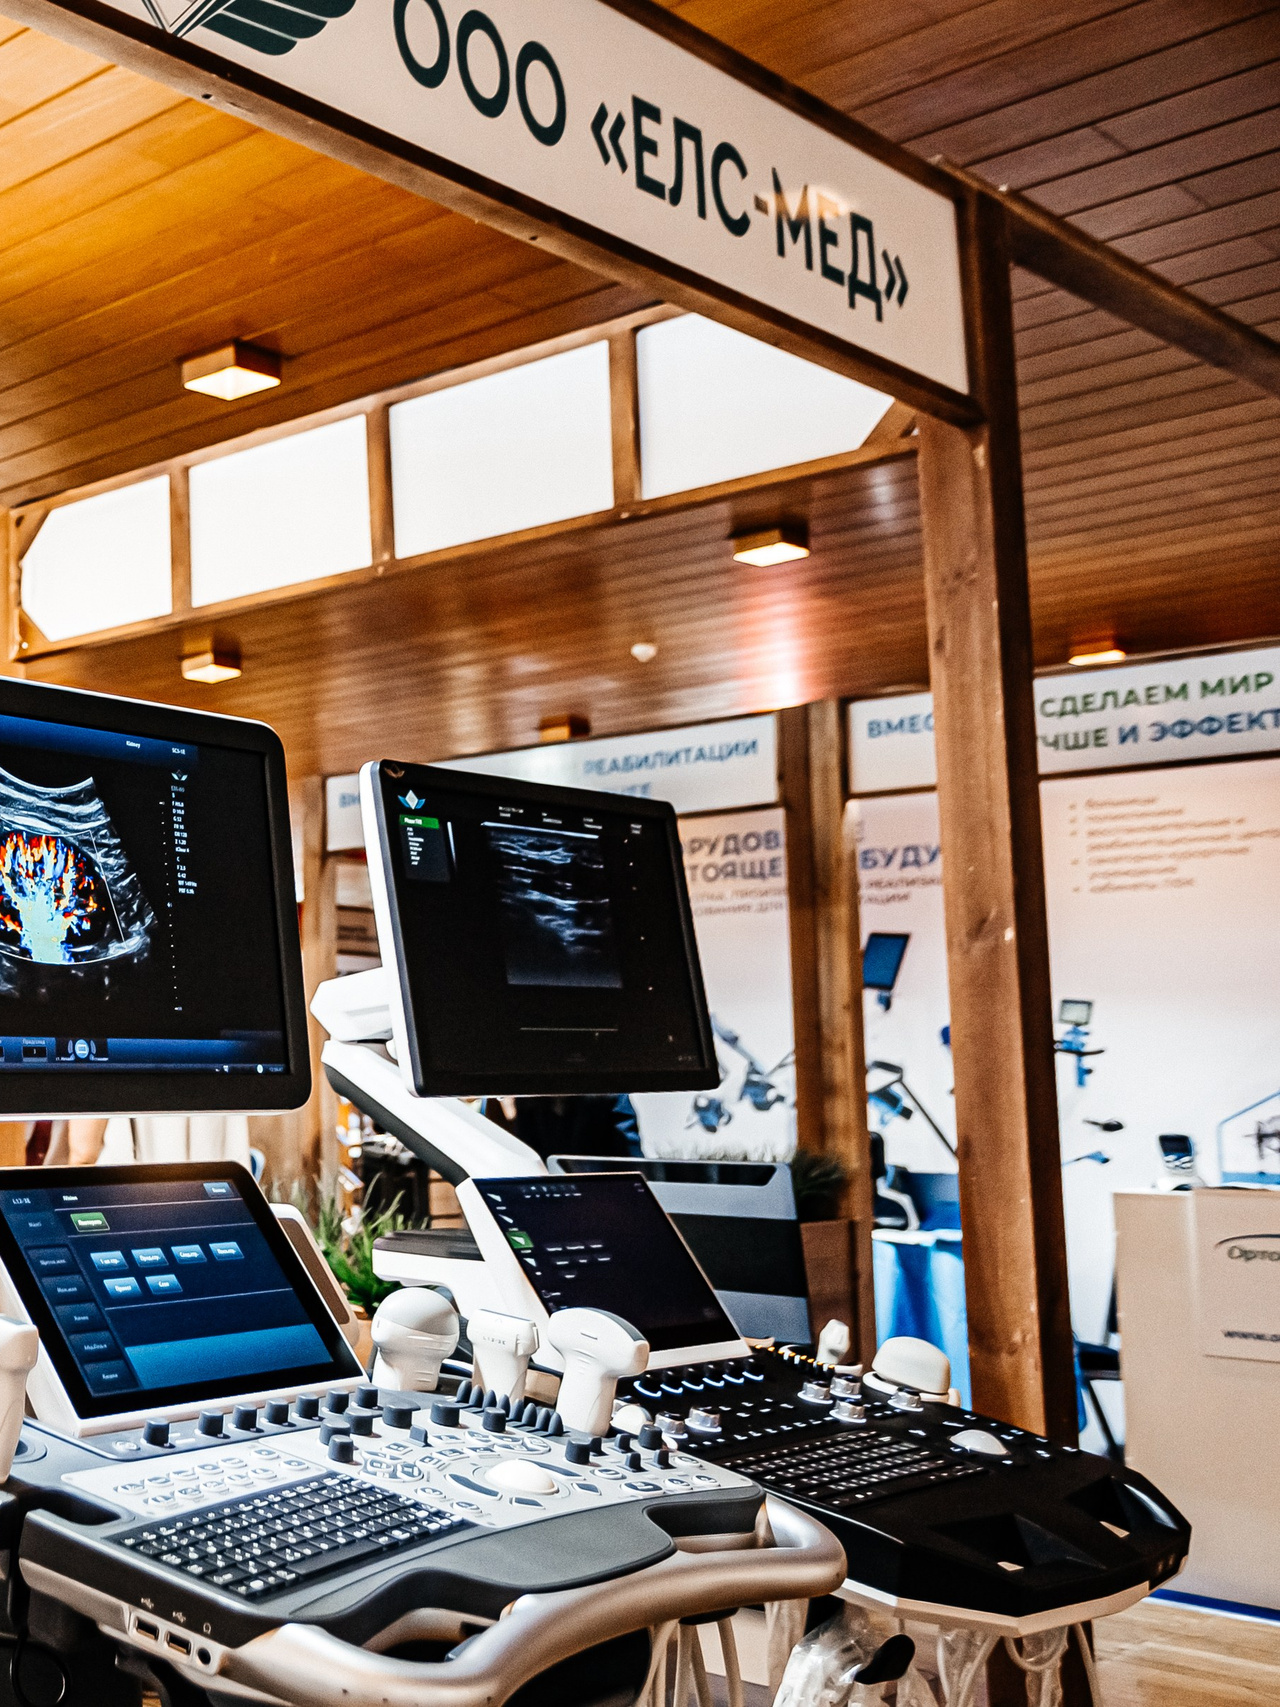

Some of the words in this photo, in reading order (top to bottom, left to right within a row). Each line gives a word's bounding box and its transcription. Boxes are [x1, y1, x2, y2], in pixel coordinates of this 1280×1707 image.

[393, 0, 567, 147] ООО
[590, 94, 909, 323] «ЕЛС-МЕД»
[1039, 682, 1190, 719] СДЕЛАЕМ
[1200, 671, 1275, 699] МИР
[1117, 724, 1139, 745] И
